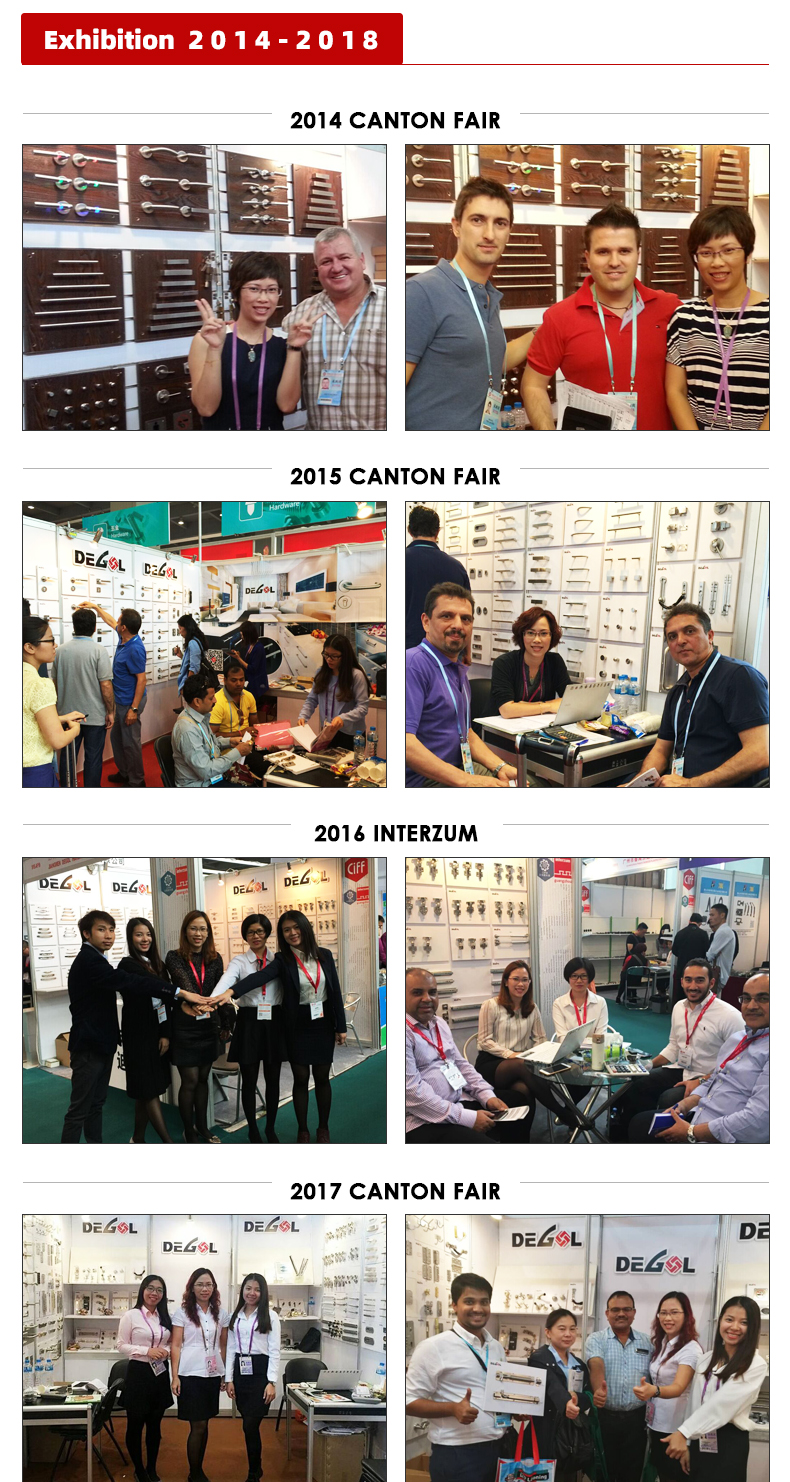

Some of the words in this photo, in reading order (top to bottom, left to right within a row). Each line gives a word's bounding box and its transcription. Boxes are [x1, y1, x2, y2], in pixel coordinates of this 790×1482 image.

[269, 501, 300, 511] Hardware
[82, 1217, 138, 1235] DEGOL
[244, 1216, 300, 1233] DEGOL
[512, 1224, 582, 1248] DEGOL
[163, 1237, 218, 1254] DEGOL
[616, 1249, 696, 1274] DEGOL
